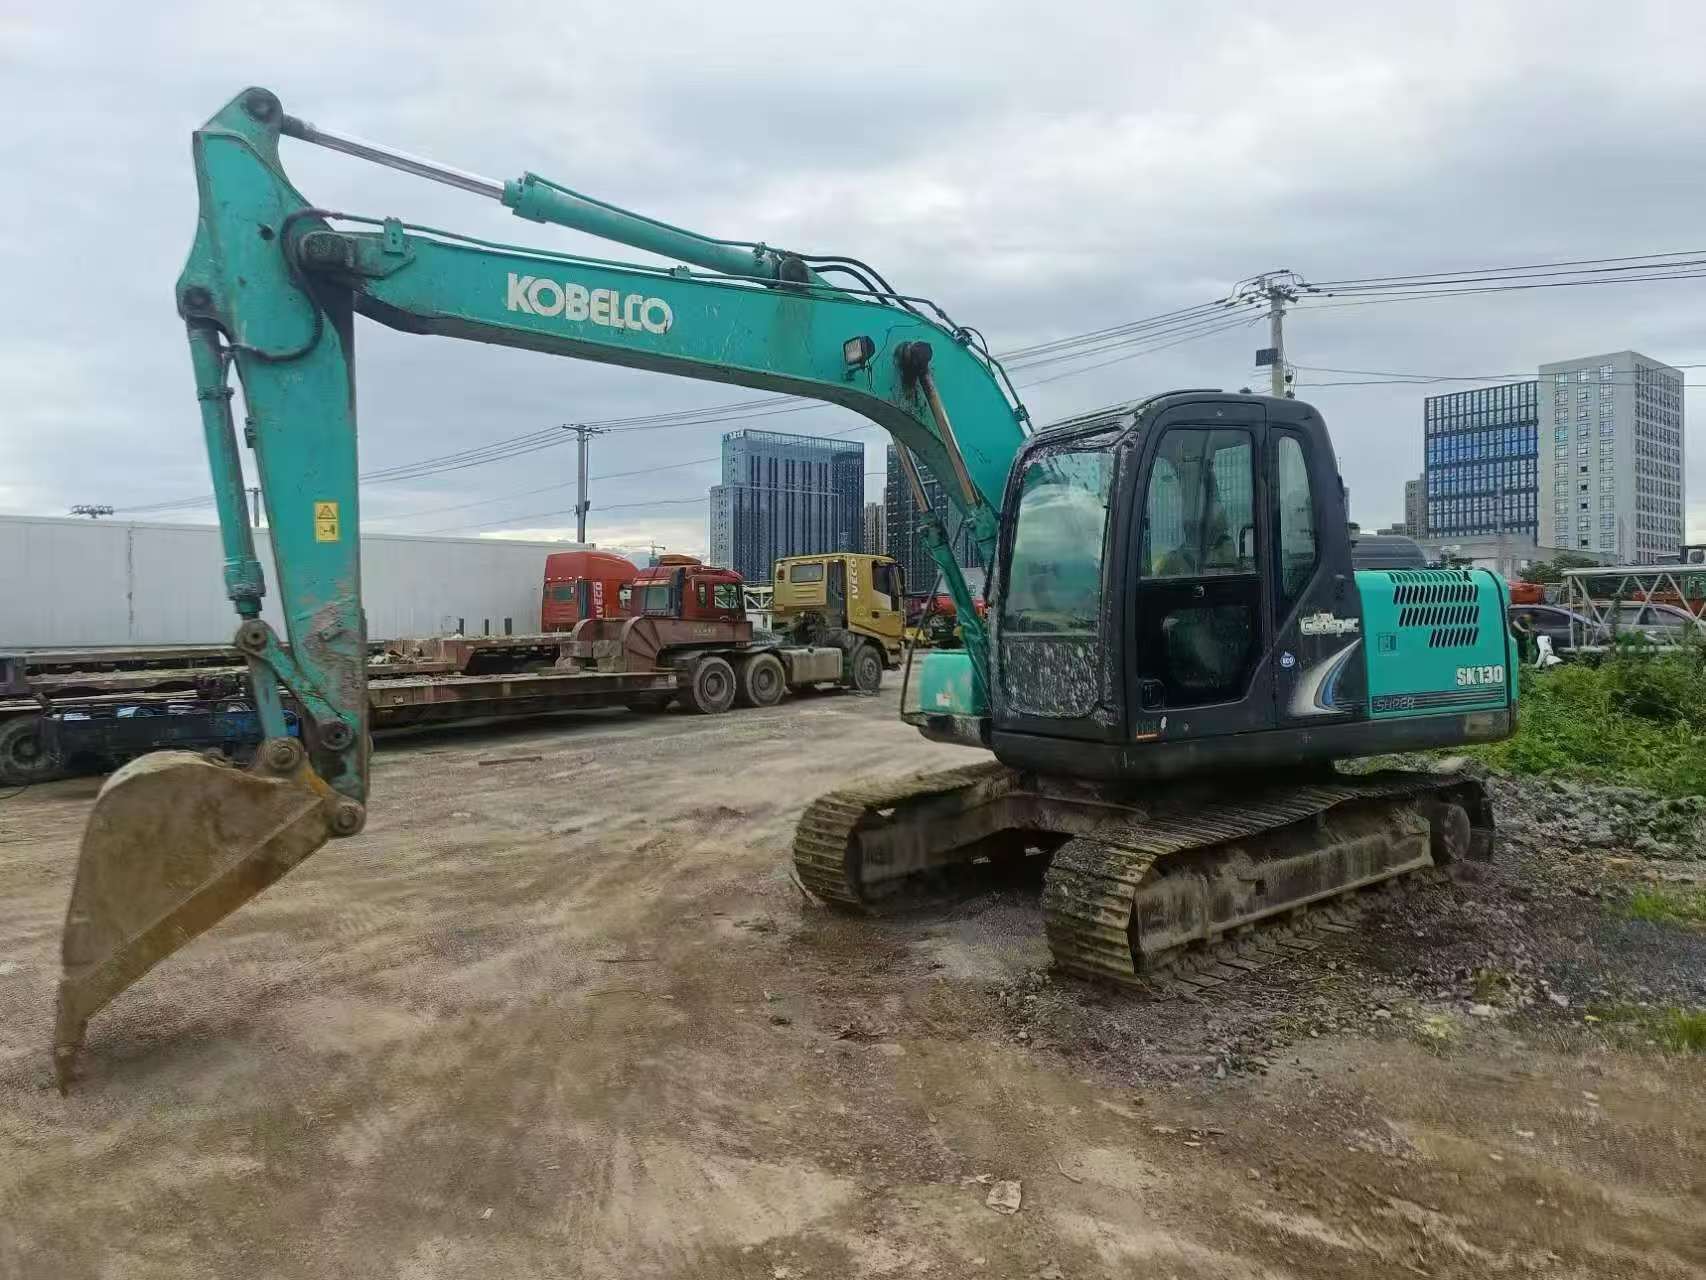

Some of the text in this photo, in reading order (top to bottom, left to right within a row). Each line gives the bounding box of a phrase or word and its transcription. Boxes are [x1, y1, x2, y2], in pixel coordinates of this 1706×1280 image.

[507, 272, 673, 334] KOBELCO
[593, 581, 603, 619] IVECO
[1456, 665, 1503, 685] SK130
